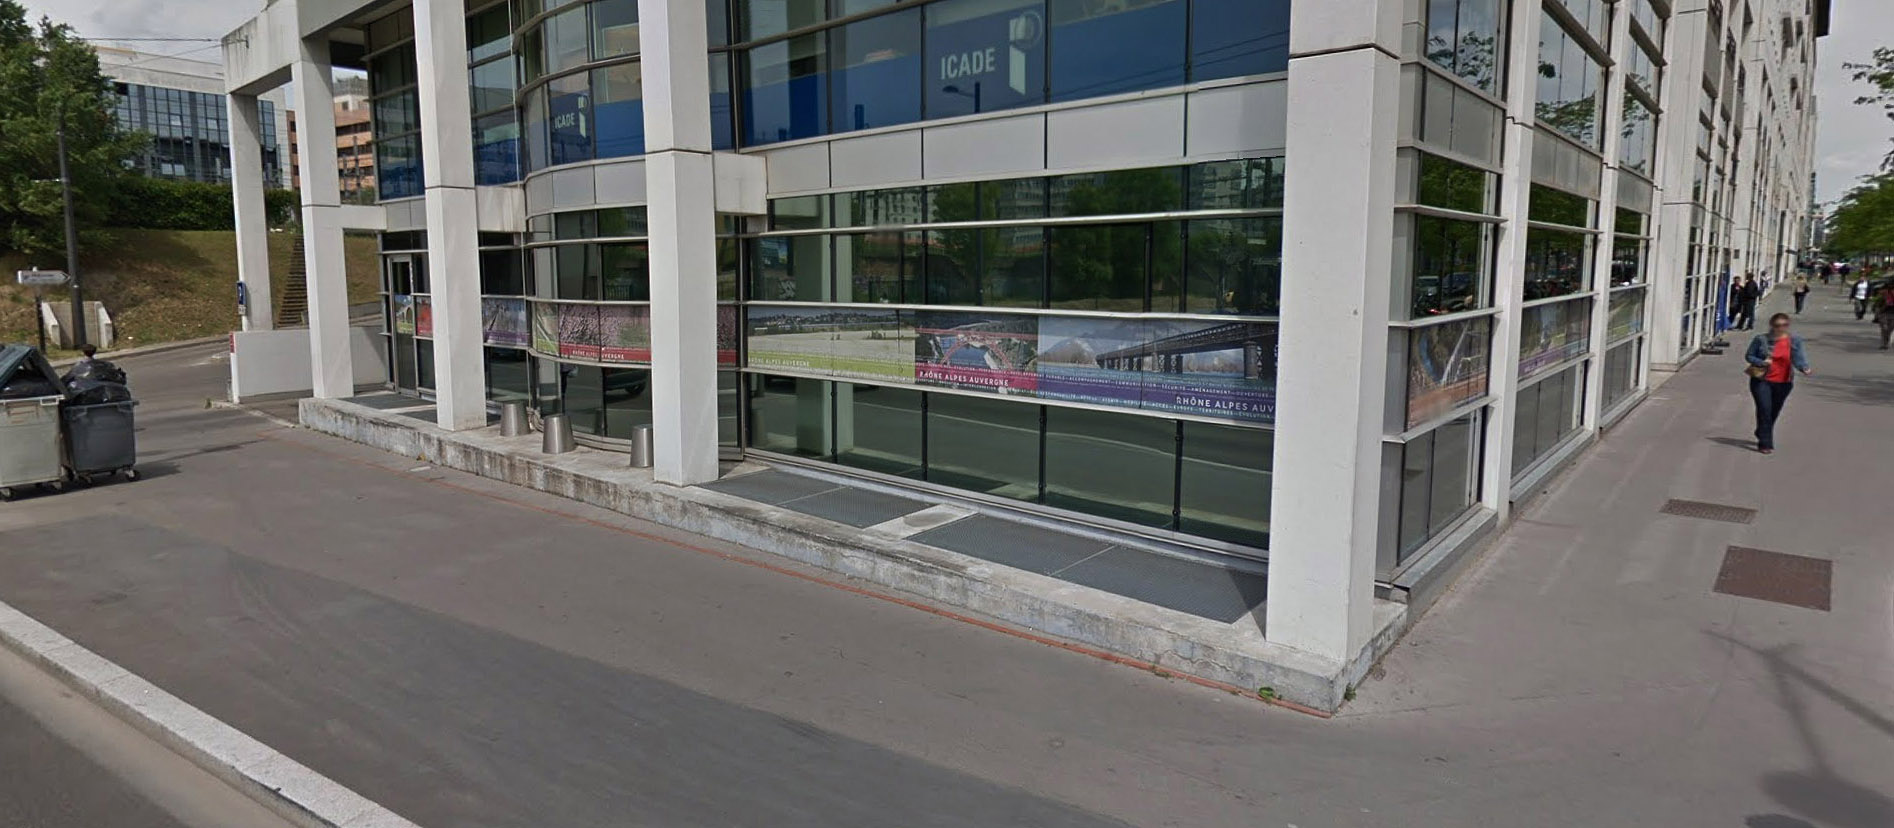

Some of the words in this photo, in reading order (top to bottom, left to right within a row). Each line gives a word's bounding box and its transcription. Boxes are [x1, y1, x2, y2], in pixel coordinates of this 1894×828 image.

[940, 47, 996, 80] ICADE
[554, 112, 575, 129] ICADE
[919, 370, 942, 379] RHÔNE
[945, 373, 967, 382] ALPES
[969, 376, 1009, 387] AUVERGNE
[1176, 396, 1211, 408] RHÔNE
[1215, 400, 1248, 411] ALPES
